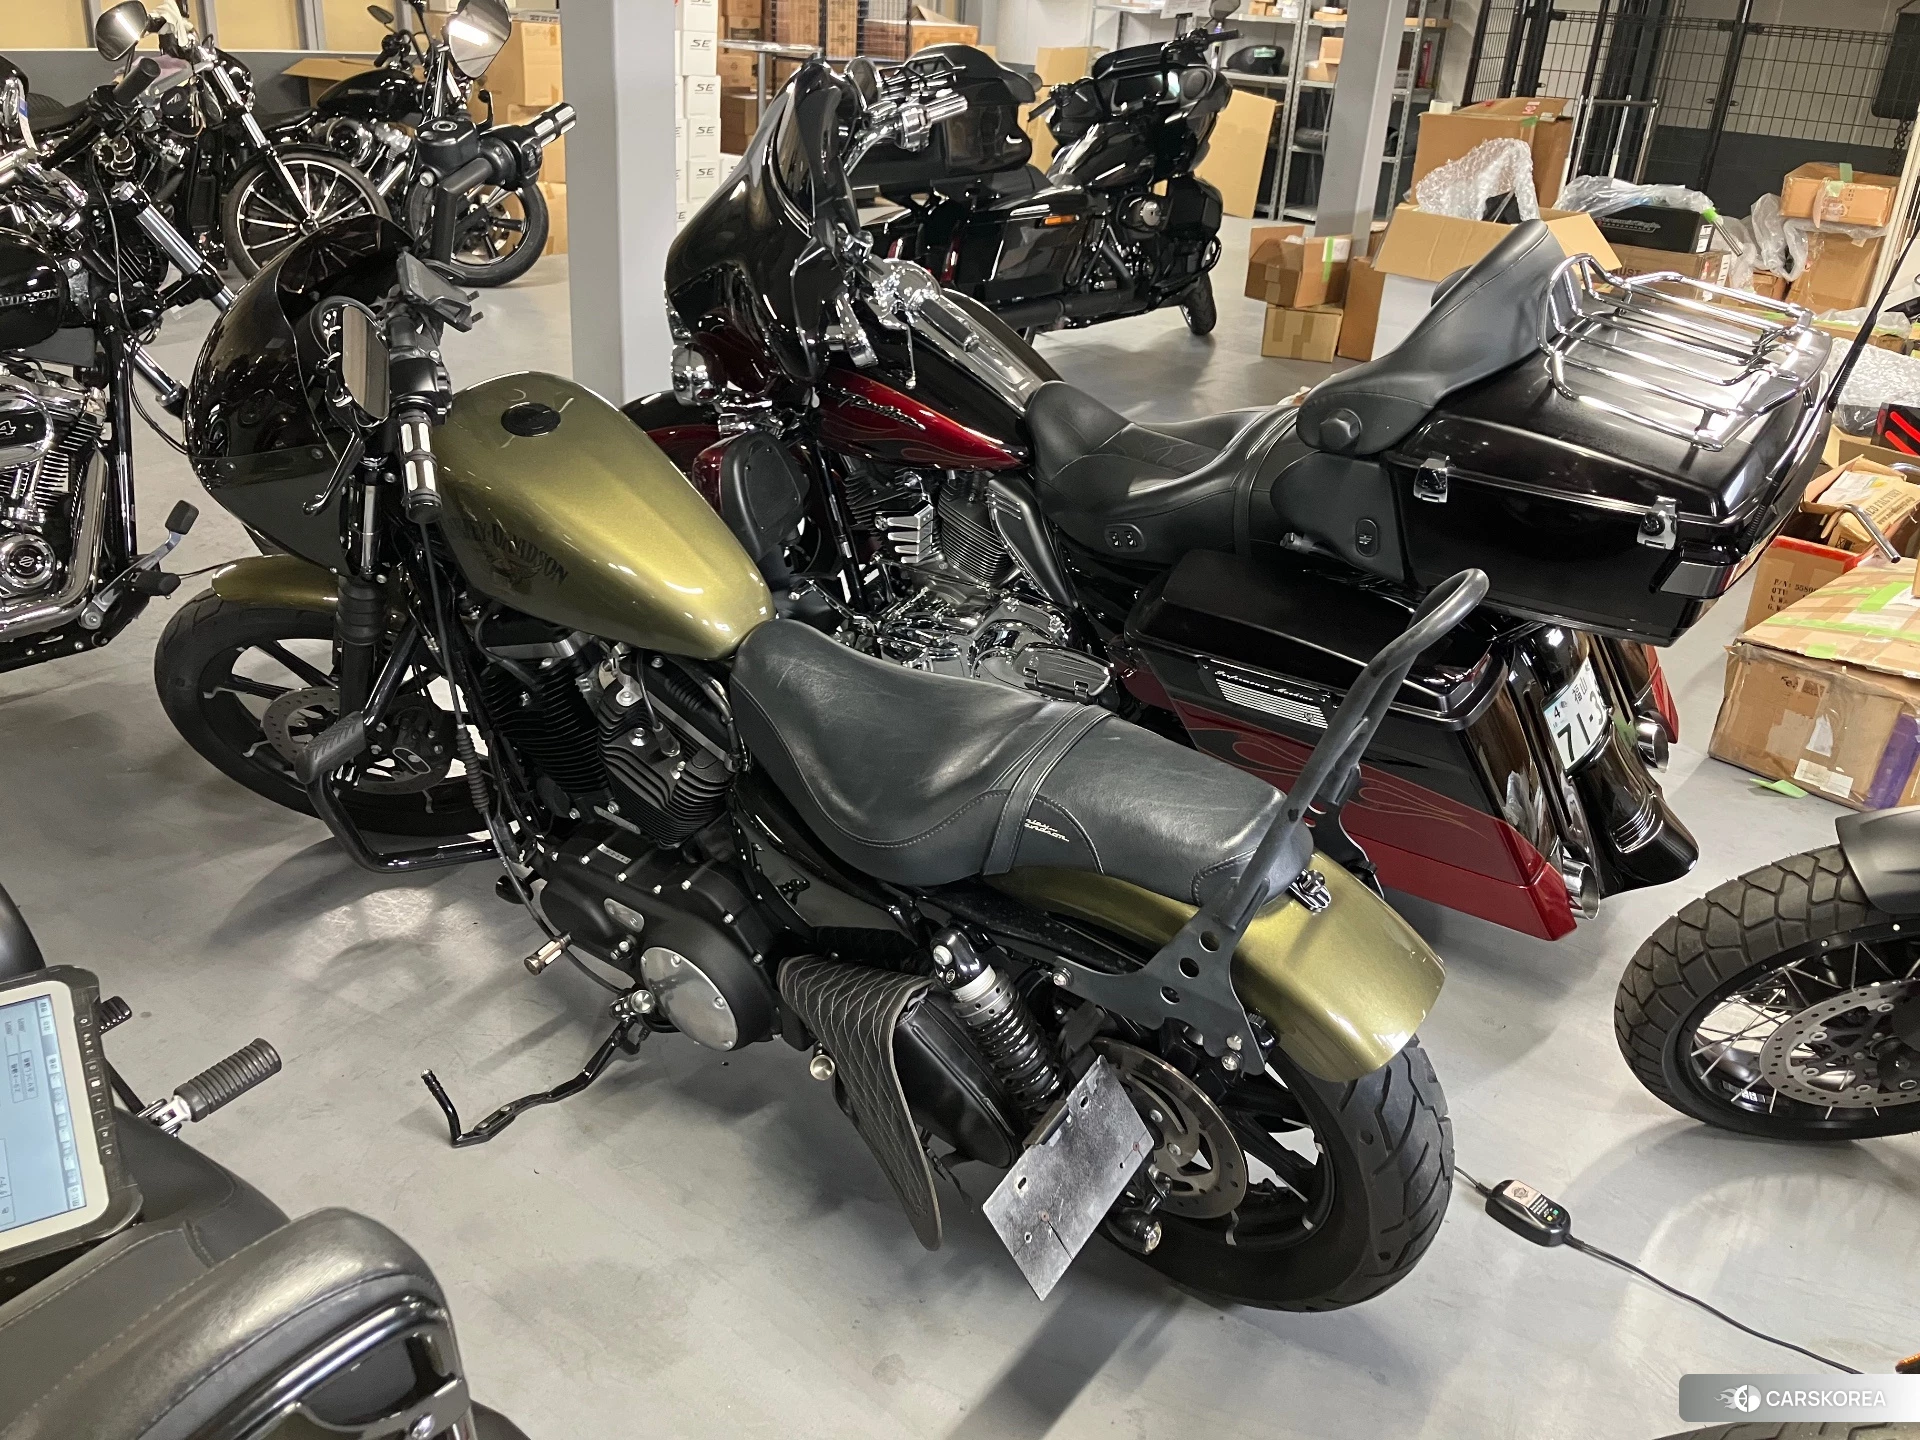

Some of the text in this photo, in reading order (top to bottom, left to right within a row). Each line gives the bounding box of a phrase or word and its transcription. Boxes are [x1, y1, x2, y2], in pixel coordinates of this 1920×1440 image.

[690, 39, 712, 48] SE
[694, 83, 716, 92] SE
[696, 126, 716, 134] SE
[696, 167, 716, 176] SE
